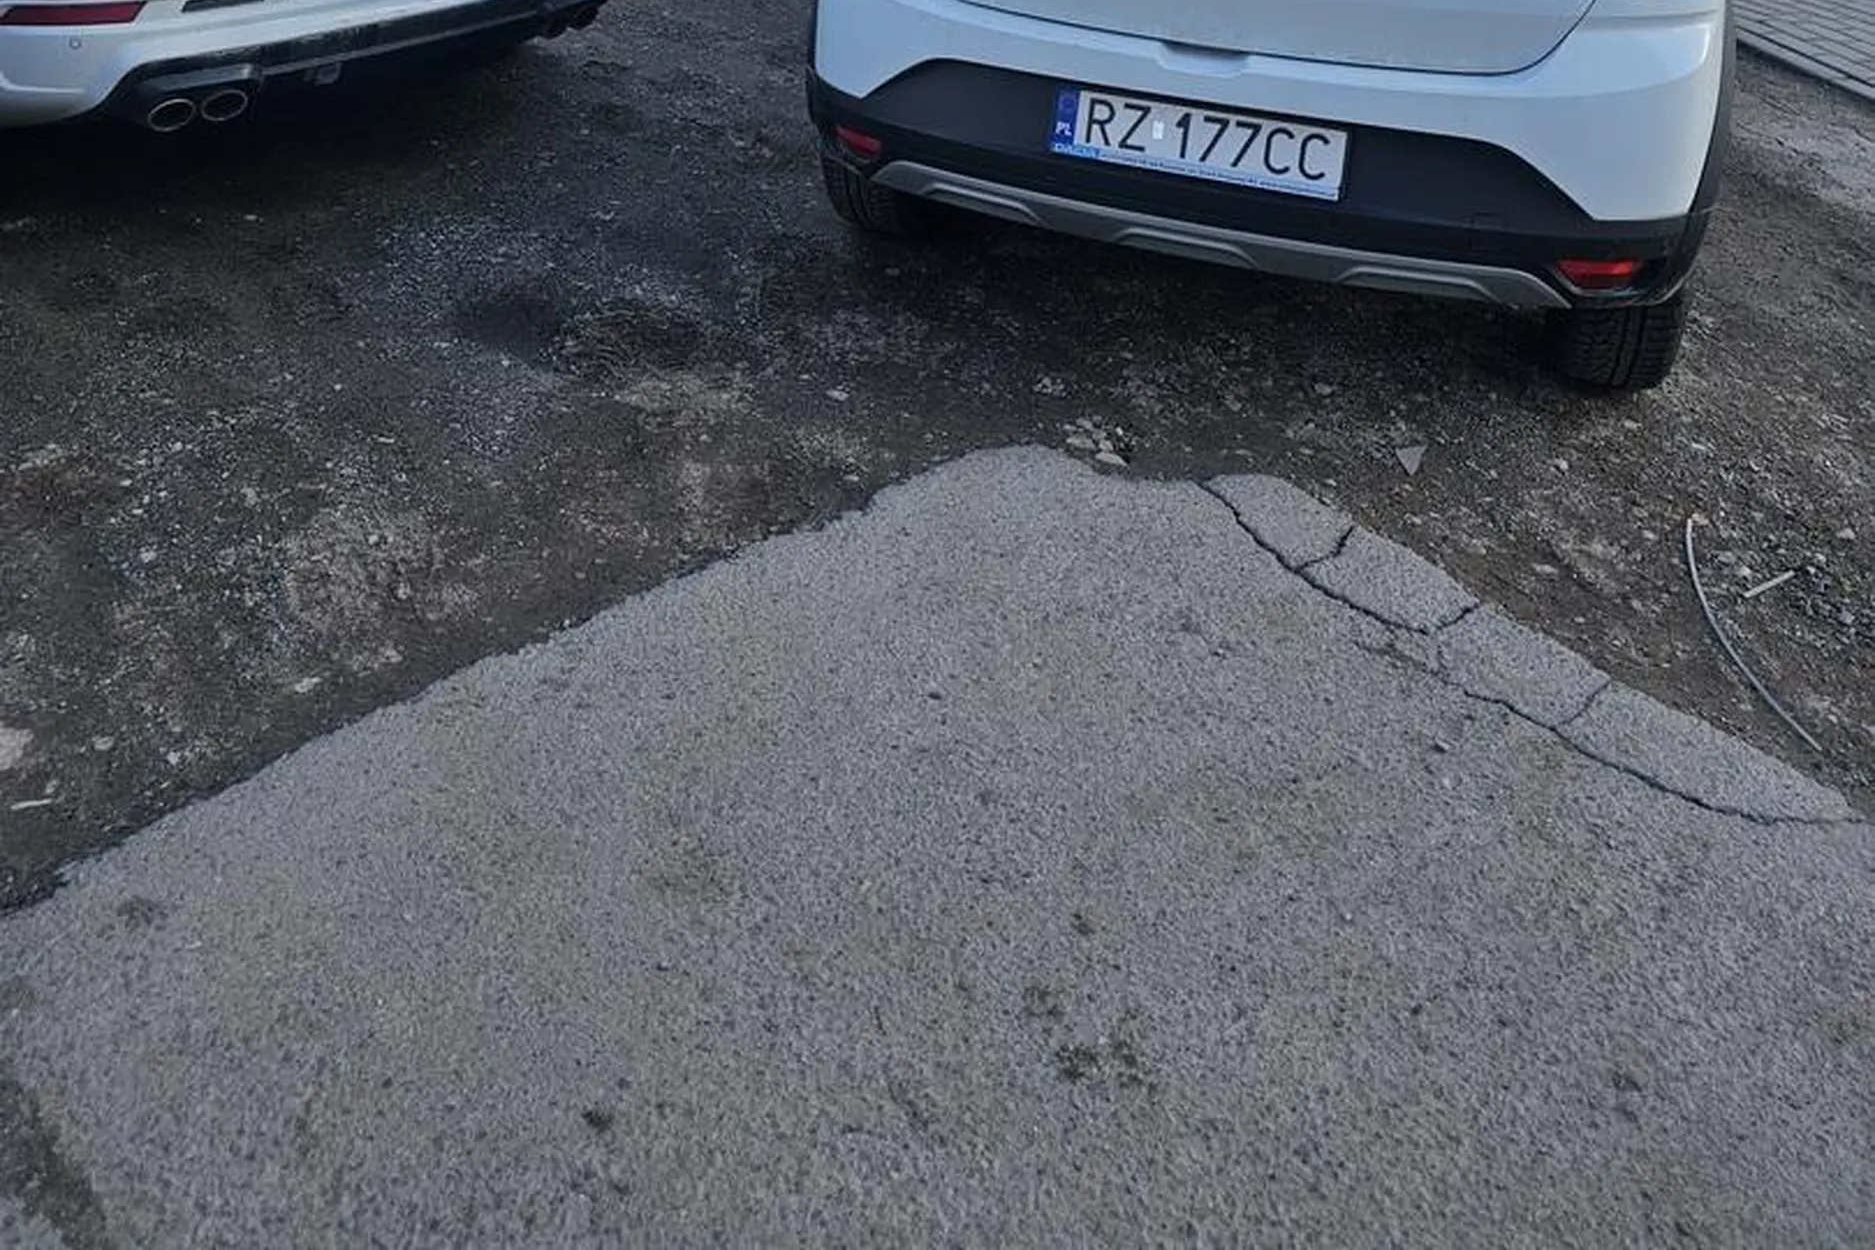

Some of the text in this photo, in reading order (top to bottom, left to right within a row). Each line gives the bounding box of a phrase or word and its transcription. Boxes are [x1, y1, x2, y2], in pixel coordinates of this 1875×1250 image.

[1055, 121, 1072, 136] PL
[1085, 97, 1151, 152] RZ
[1175, 111, 1330, 180] 177CC
